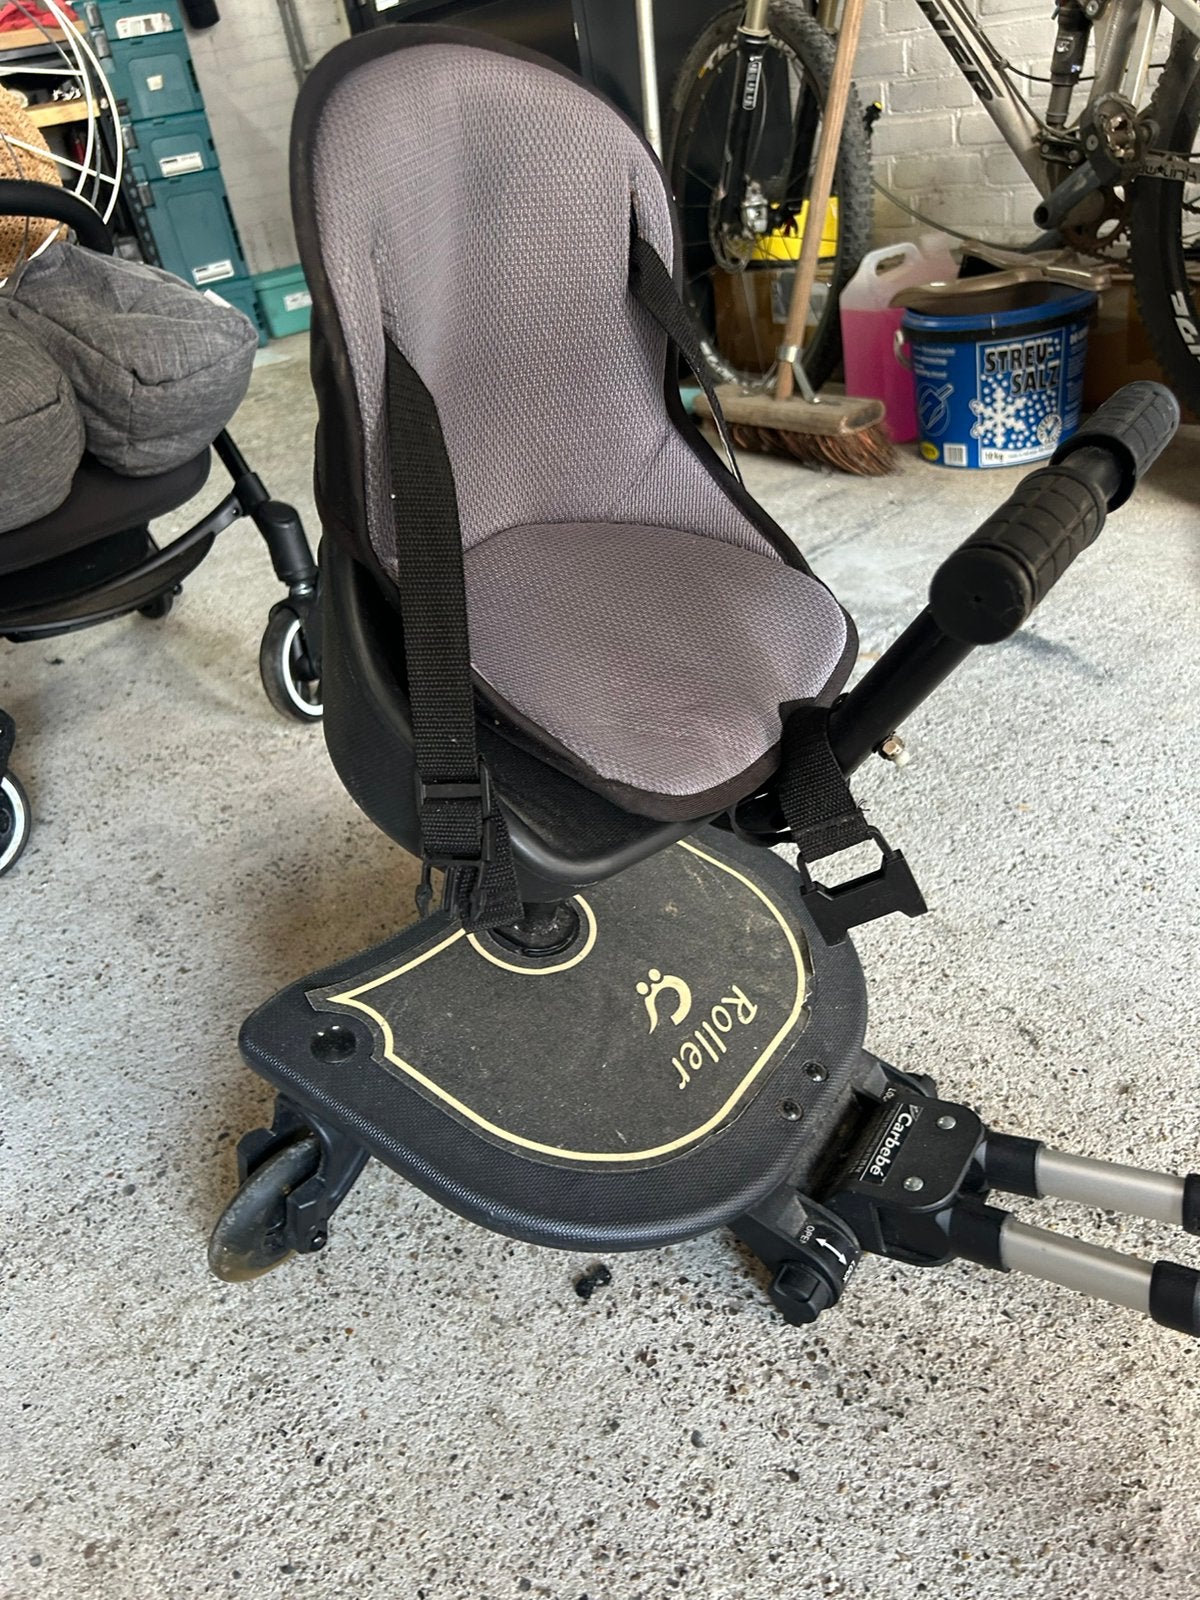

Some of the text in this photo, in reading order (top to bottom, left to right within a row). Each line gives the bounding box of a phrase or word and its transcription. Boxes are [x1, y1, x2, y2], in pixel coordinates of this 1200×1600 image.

[1010, 361, 1060, 395] SALZ
[672, 984, 758, 1090] Roller
[870, 1113, 912, 1177] Carbebé
